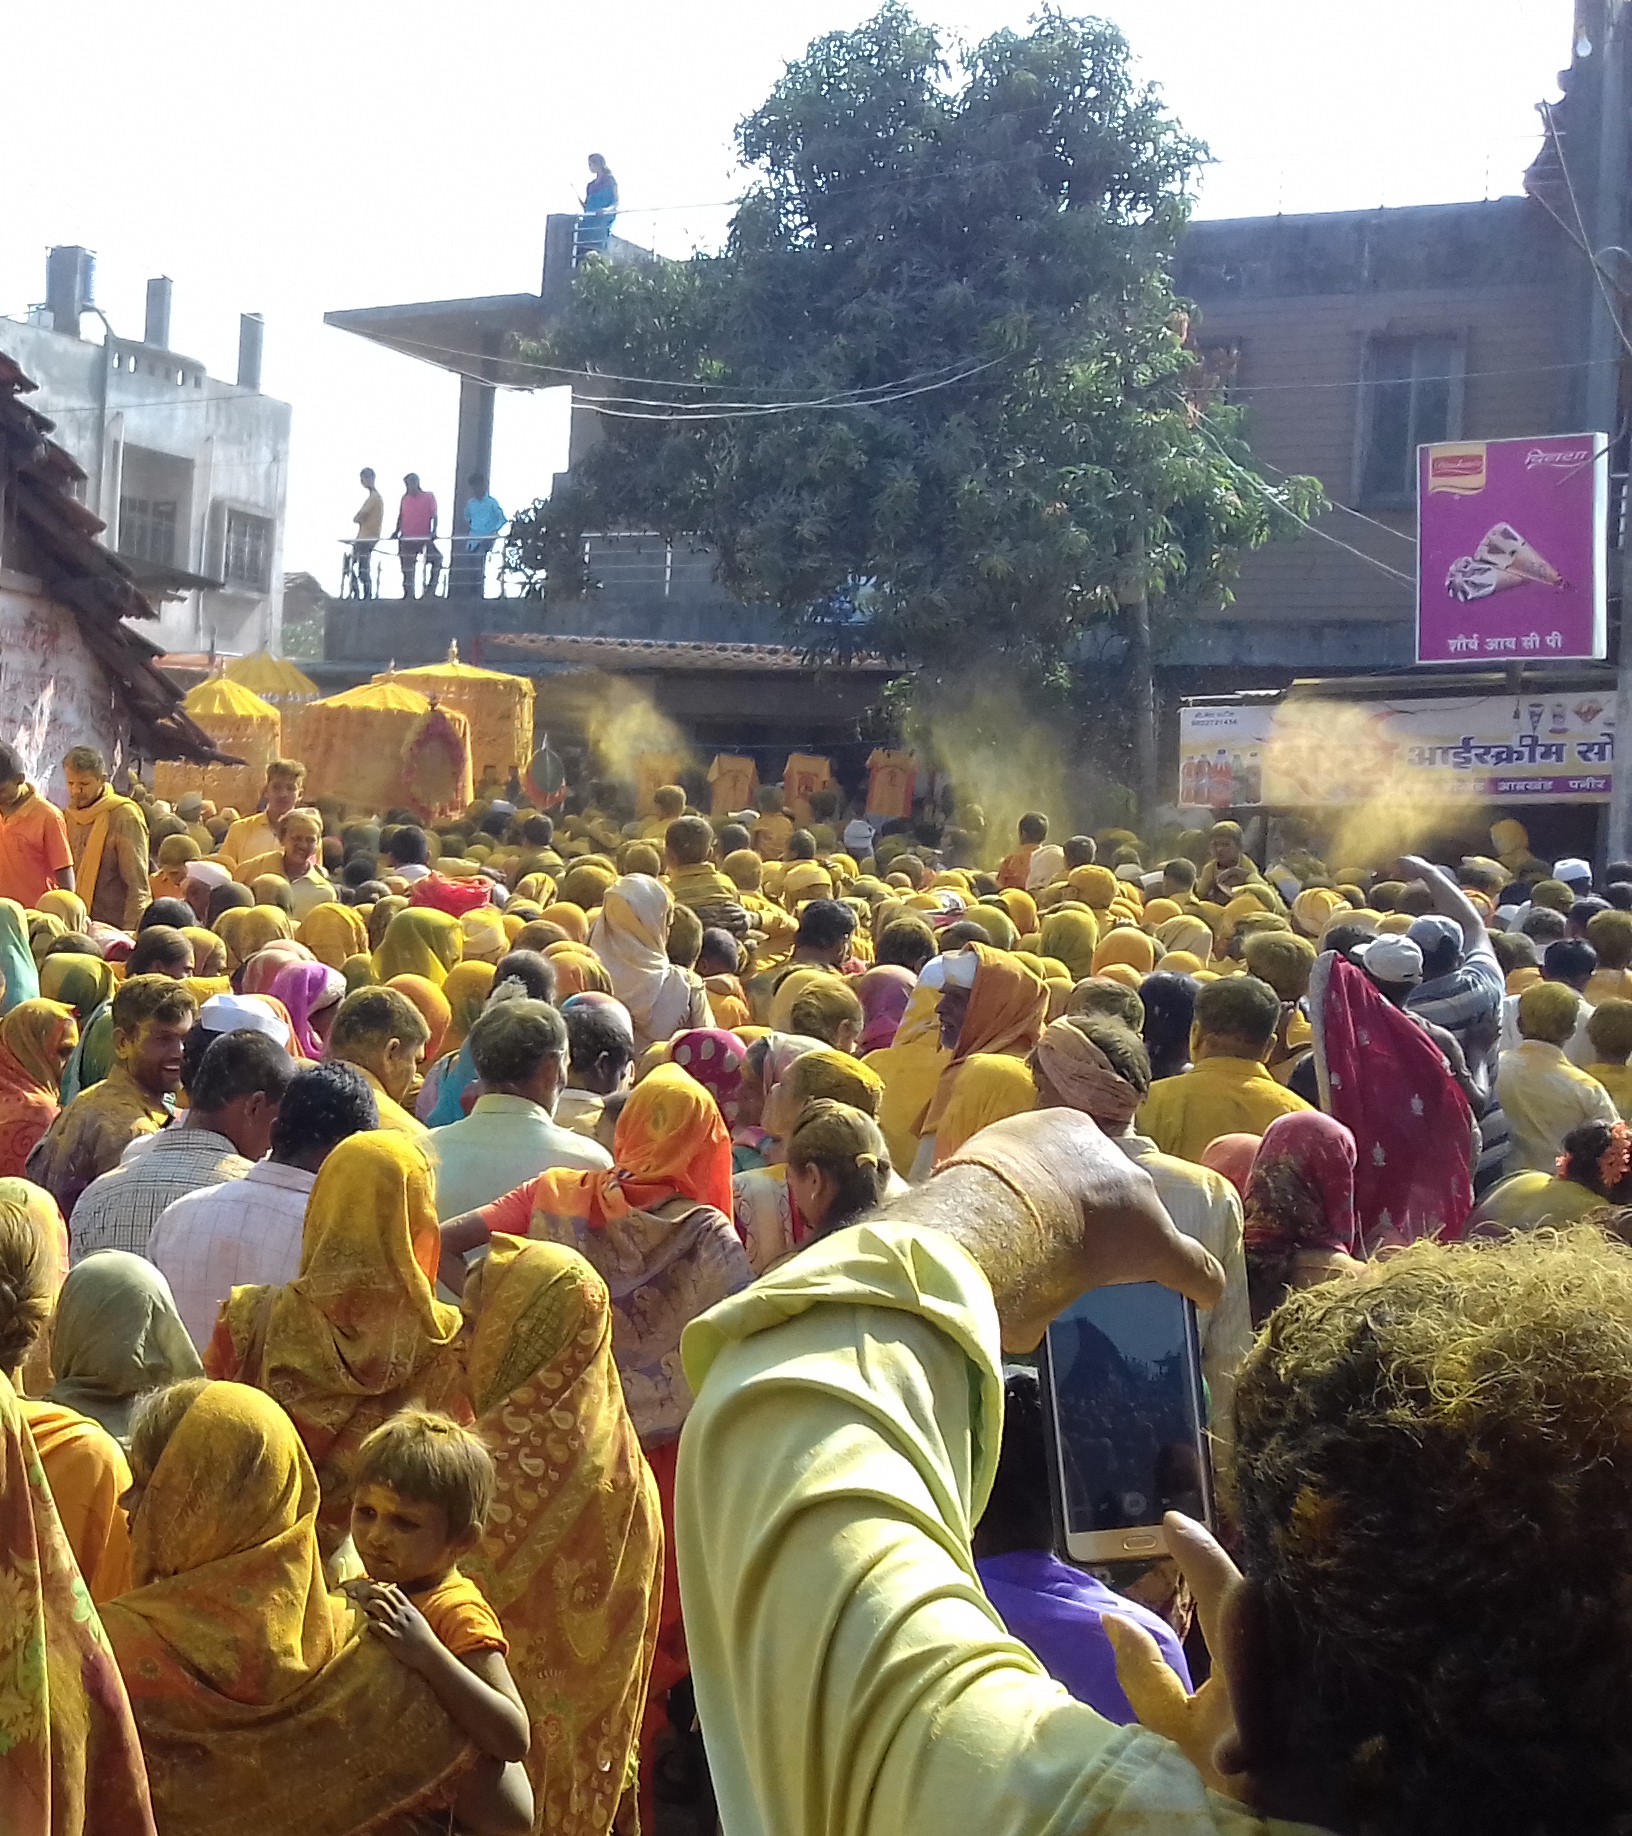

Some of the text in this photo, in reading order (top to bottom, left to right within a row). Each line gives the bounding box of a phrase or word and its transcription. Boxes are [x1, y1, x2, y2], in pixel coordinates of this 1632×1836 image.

[1485, 637, 1517, 650] आय
[1521, 632, 1541, 649] सी
[1545, 631, 1563, 649] पी
[1407, 735, 1567, 769] आईस्क्रीम
[1575, 732, 1615, 764] सो
[1568, 777, 1606, 790] पनीर
